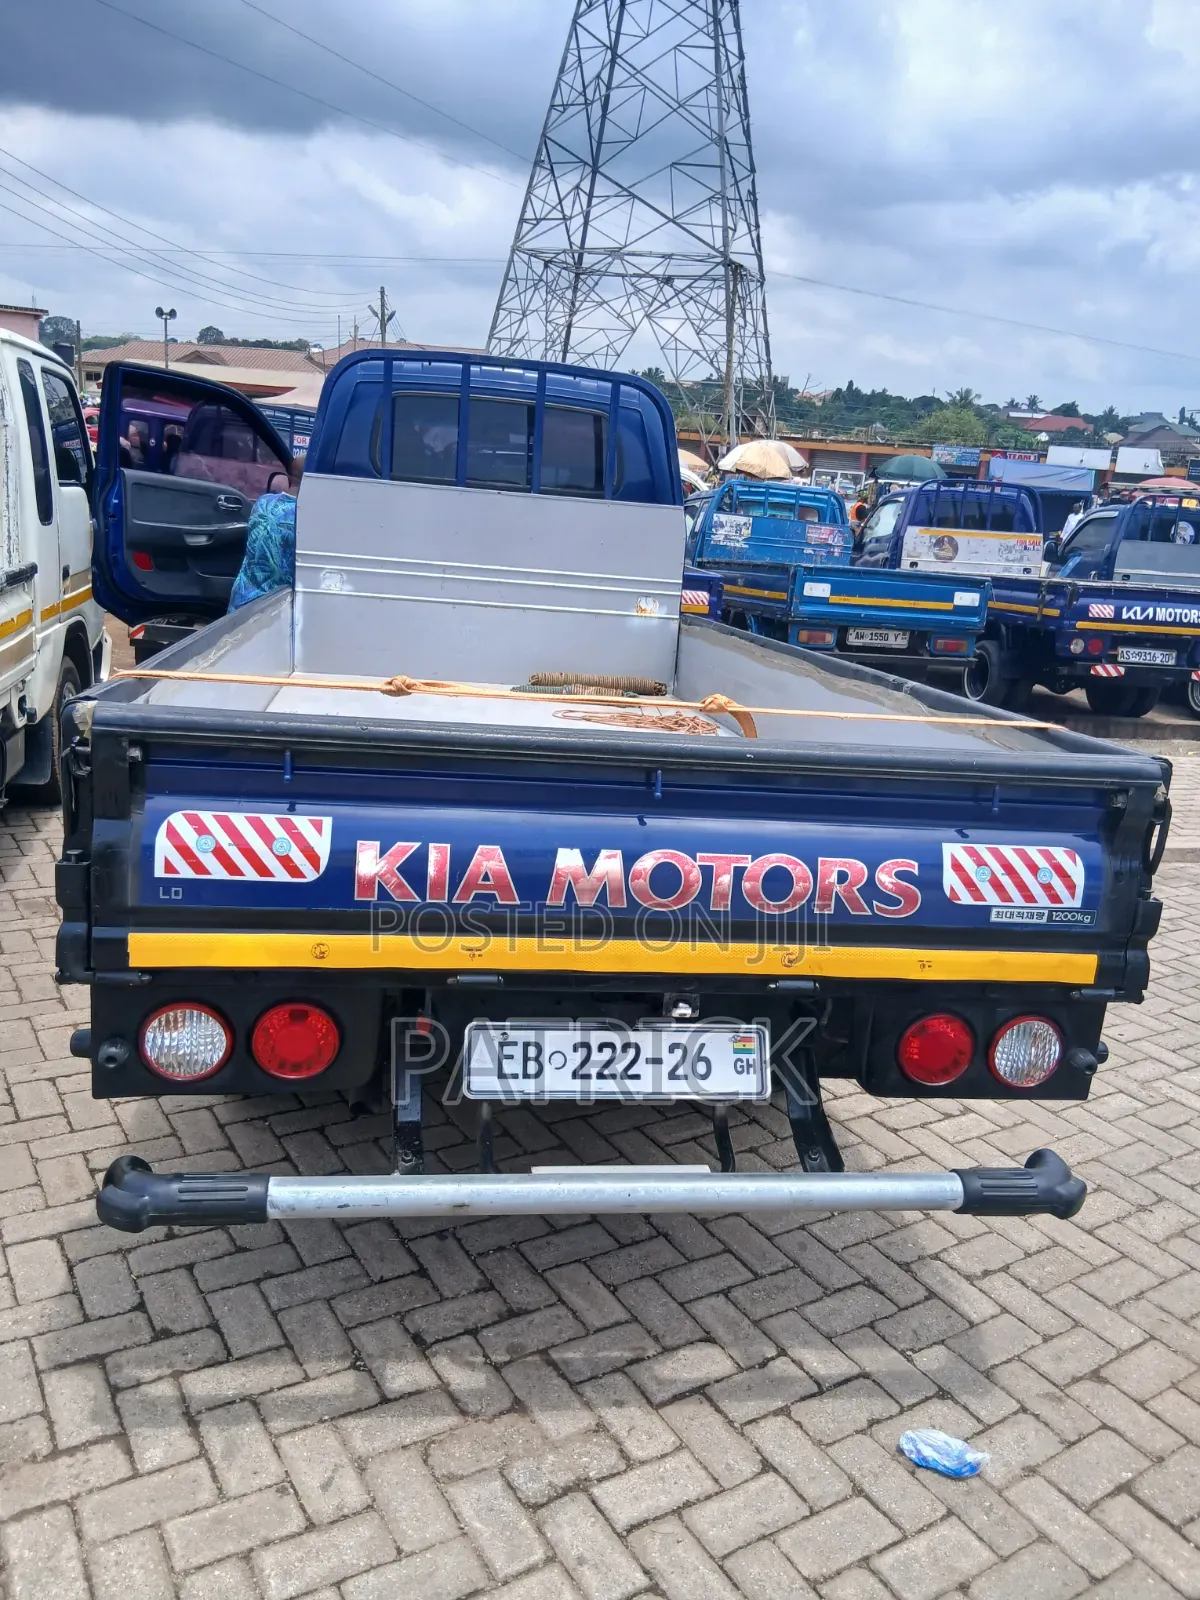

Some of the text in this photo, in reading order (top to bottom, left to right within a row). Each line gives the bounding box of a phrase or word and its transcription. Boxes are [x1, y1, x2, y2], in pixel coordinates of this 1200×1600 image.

[1008, 453, 1031, 461] TEAM
[1122, 605, 1200, 624] KIA MOTOR
[869, 632, 889, 641] 1550
[354, 840, 922, 919] KIA MOTORS
[994, 909, 1046, 921] 최대적재량
[1051, 910, 1092, 923] 1200kg
[497, 1040, 712, 1081] EB 222-26
[733, 1057, 757, 1075] GH
